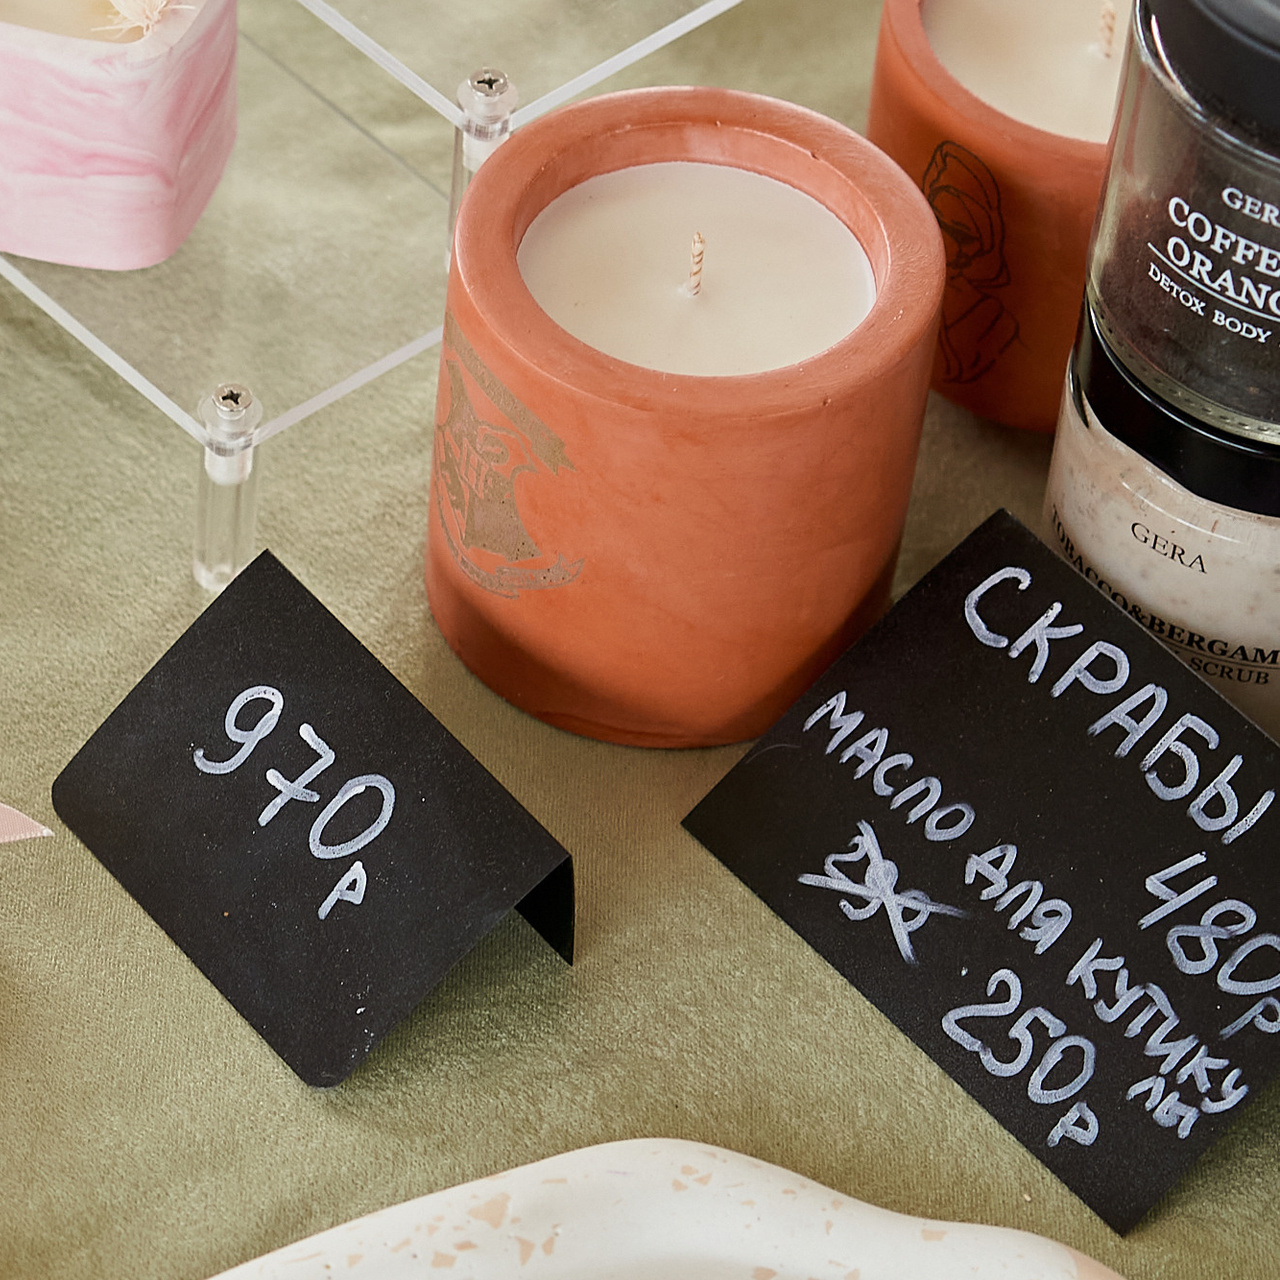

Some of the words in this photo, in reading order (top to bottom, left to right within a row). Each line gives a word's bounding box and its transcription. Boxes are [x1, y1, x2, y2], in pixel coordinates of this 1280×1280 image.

[1147, 261, 1207, 317] DETOX
[1211, 309, 1273, 344] BODY
[1130, 521, 1208, 575] GERA
[1189, 656, 1270, 685] SCRUB
[964, 566, 1276, 845] СКРАБЫ
